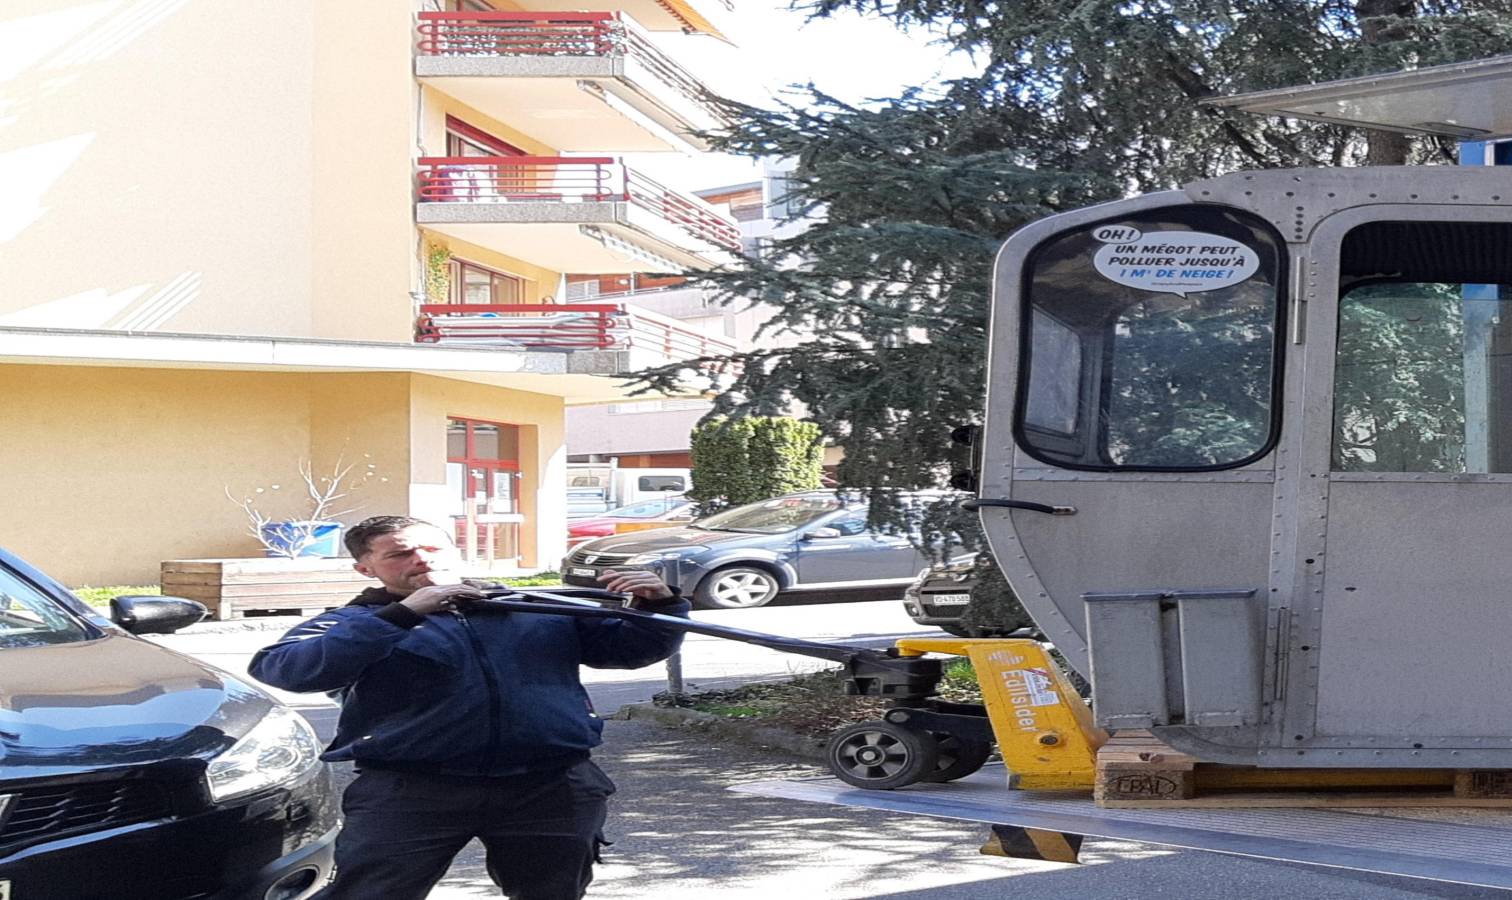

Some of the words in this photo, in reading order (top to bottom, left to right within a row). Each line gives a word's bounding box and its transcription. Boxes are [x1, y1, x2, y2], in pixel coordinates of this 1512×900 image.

[1115, 245, 1137, 254] UN
[1142, 243, 1195, 254] MÉGOT
[1199, 246, 1239, 255] PEUT
[1108, 257, 1175, 266] POLLUER
[1178, 255, 1245, 267] JUSQU'À
[1156, 269, 1176, 278] DE
